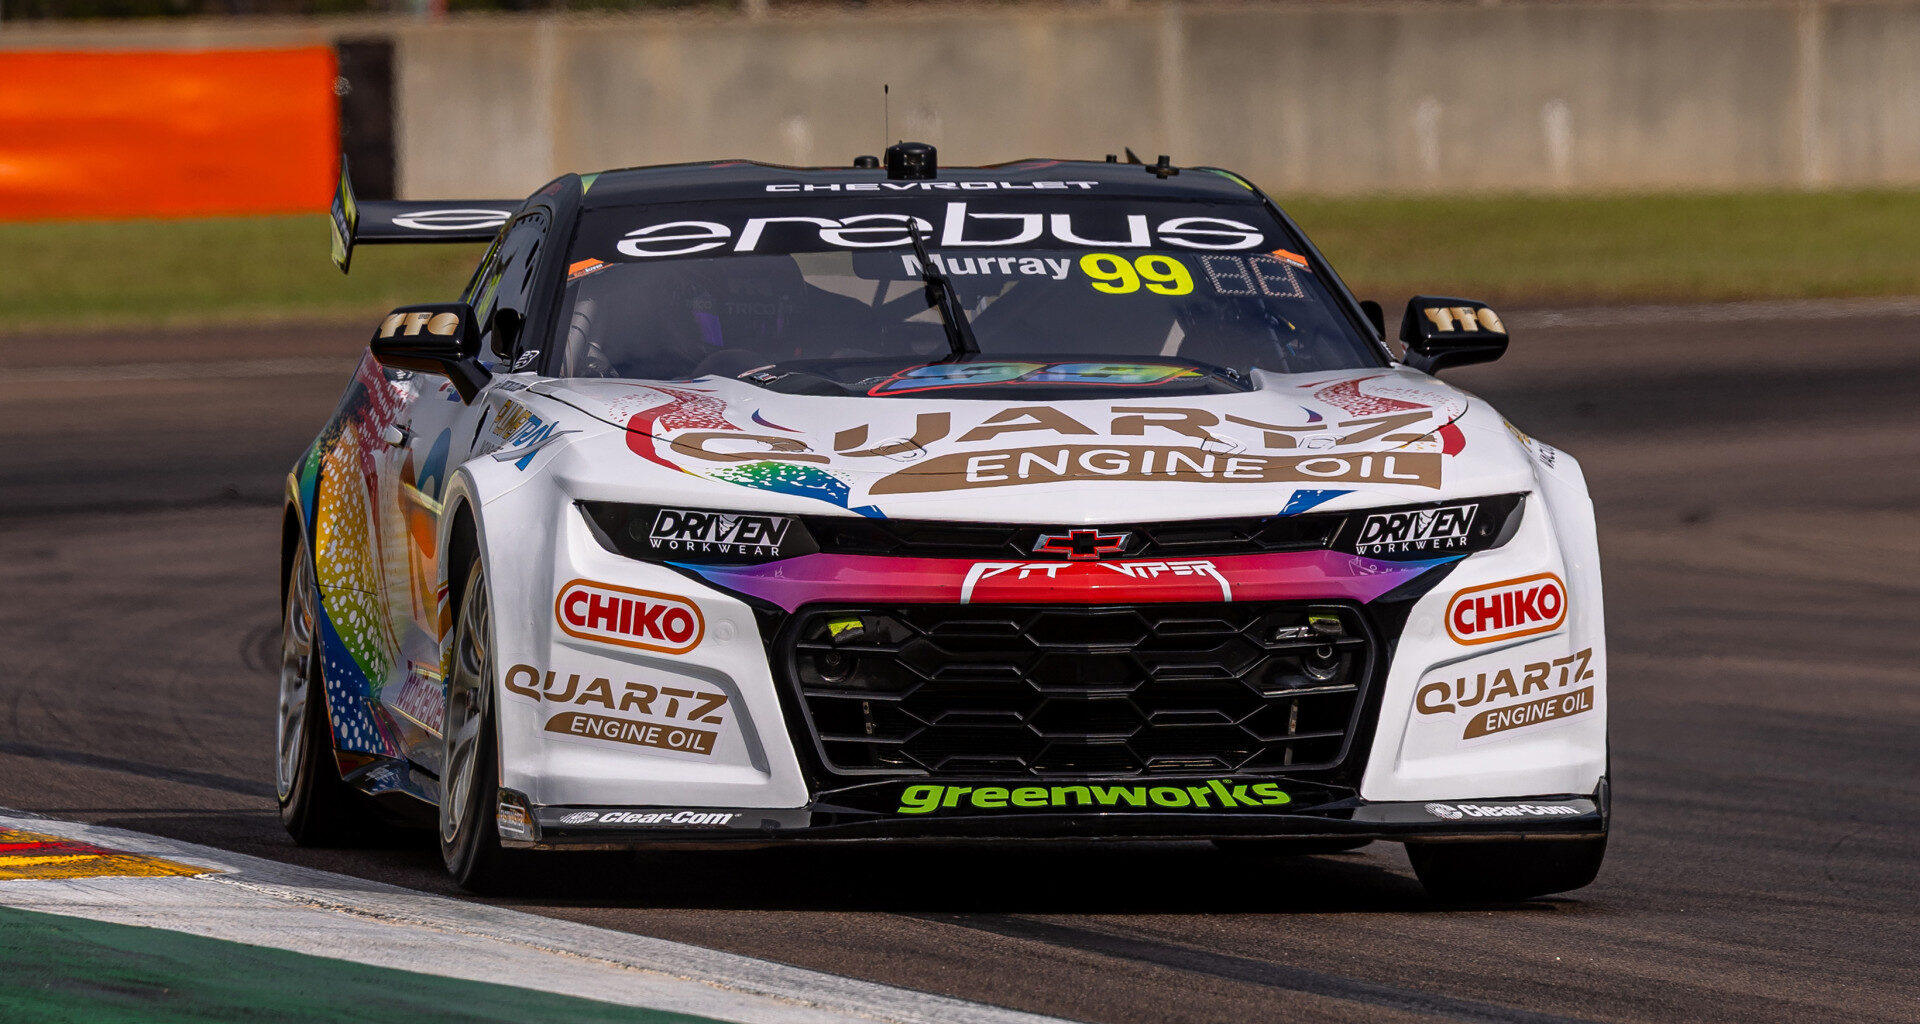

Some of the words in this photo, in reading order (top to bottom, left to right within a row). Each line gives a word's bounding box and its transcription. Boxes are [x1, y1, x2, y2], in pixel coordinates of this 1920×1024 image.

[766, 180, 1099, 193] CHEVROLET
[616, 202, 1264, 257] erebus
[901, 254, 1071, 281] Murray
[1079, 253, 1195, 296] 99
[671, 406, 1434, 464] QUARTZ
[967, 447, 1266, 483] ENGINE
[1296, 456, 1421, 480] OIL
[650, 510, 794, 546] DRIVEN
[1356, 504, 1479, 544] DRIVEN
[650, 538, 780, 557] WORKWEAR
[1356, 537, 1468, 555] WORKWEAR
[1098, 560, 1232, 602] VIPER
[564, 590, 695, 643] CHIKO
[1454, 583, 1562, 635] CHIKO
[1276, 626, 1322, 640] ZL
[504, 664, 729, 725] QUARTZ
[1416, 648, 1594, 715] QUARTZ
[1486, 700, 1556, 732] ENGINE
[1562, 693, 1590, 714] OIL
[571, 717, 663, 745] ENGINE
[668, 730, 706, 751] OIL
[897, 779, 1291, 814] greenworks
